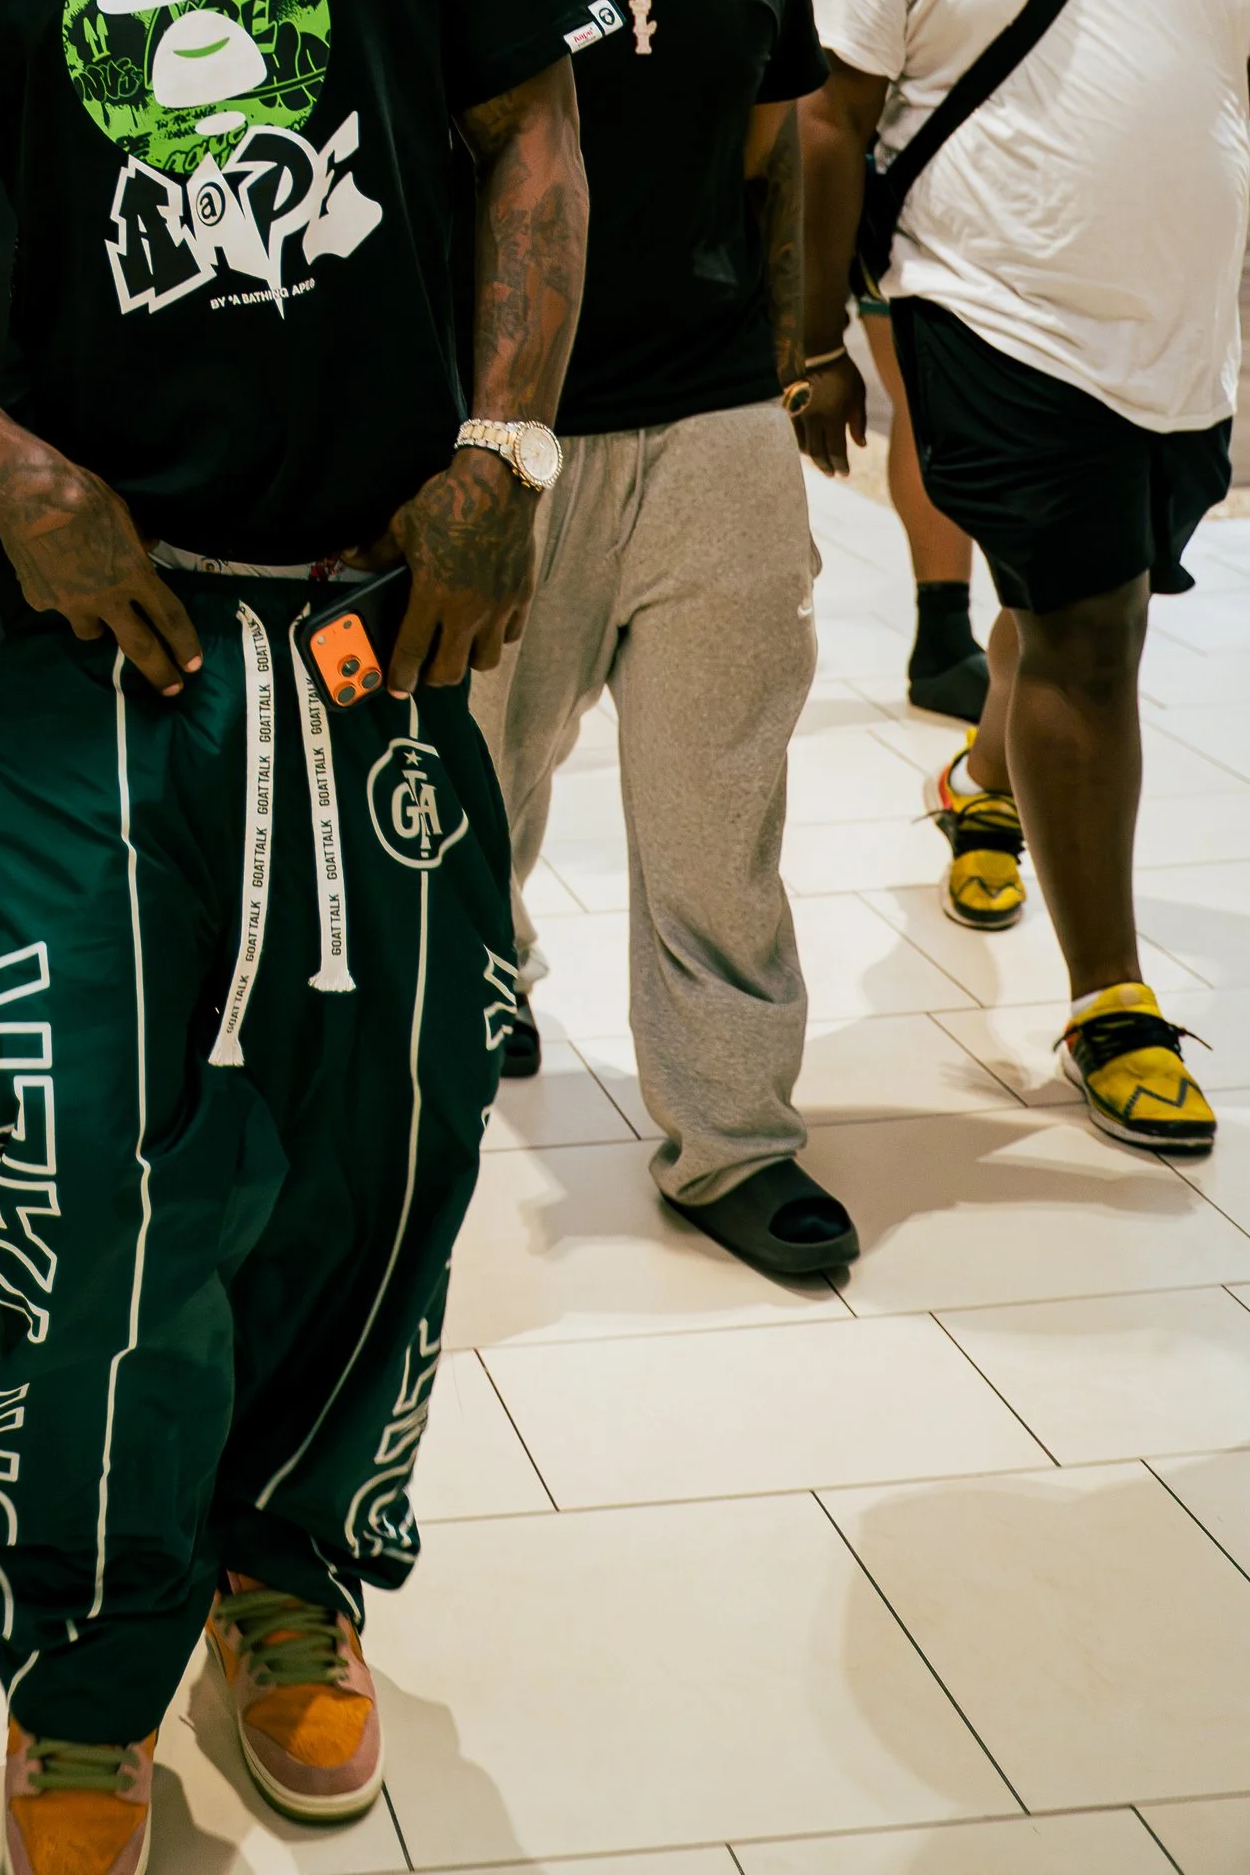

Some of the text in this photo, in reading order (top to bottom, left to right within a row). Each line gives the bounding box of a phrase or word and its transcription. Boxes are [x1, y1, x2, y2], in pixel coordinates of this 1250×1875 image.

[210, 296, 226, 310] BY
[241, 286, 289, 305] BATHING
[249, 619, 269, 672] GOAT TALK
[259, 684, 271, 743] GOAT TALK
[306, 678, 322, 735] GOAT TALK
[257, 755, 270, 815] GOAT TALK
[313, 747, 330, 807] GOAT TALK
[252, 827, 267, 888] GOAT TALK
[321, 820, 337, 880] GOAT TALK
[246, 900, 261, 962] GOAT TALK
[329, 894, 342, 956] GOAT TALK
